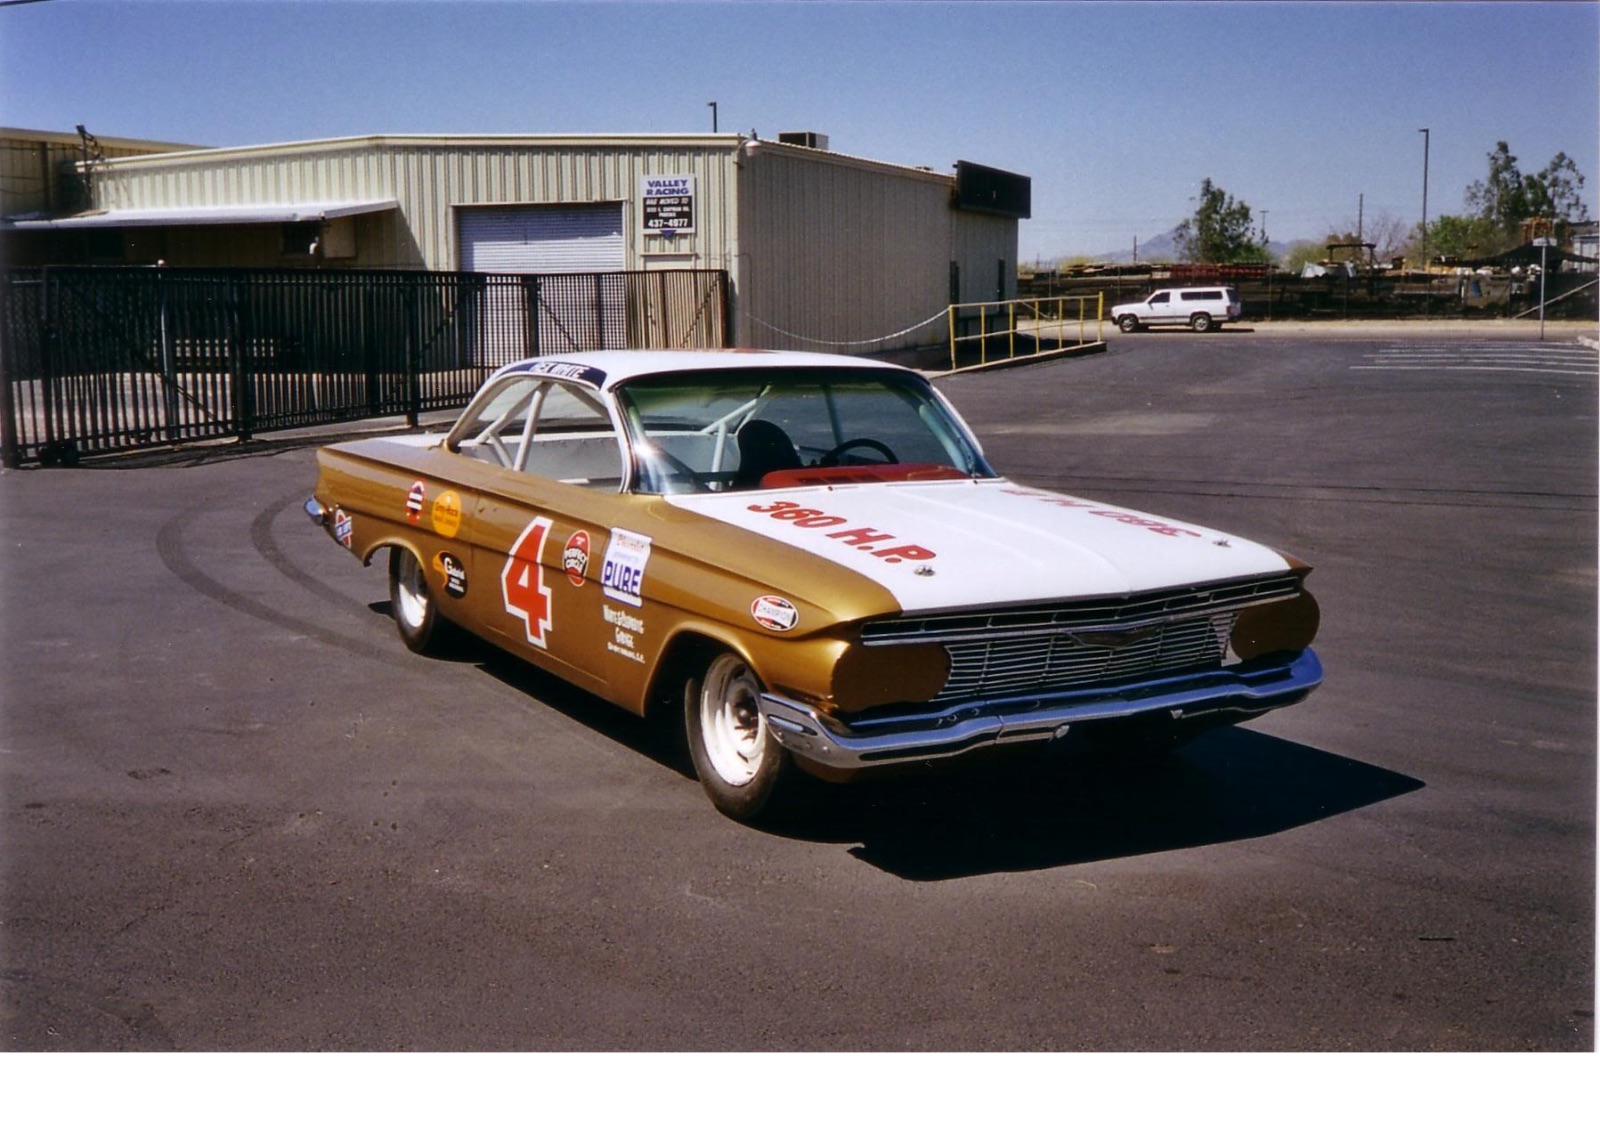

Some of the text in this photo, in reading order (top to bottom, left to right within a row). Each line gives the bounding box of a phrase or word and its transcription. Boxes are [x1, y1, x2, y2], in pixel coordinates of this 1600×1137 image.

[646, 187, 689, 196] RACING
[648, 179, 688, 187] VALLEY
[747, 501, 937, 564] 360 H.P.
[501, 516, 553, 650] 4
[604, 560, 641, 597] PURE
